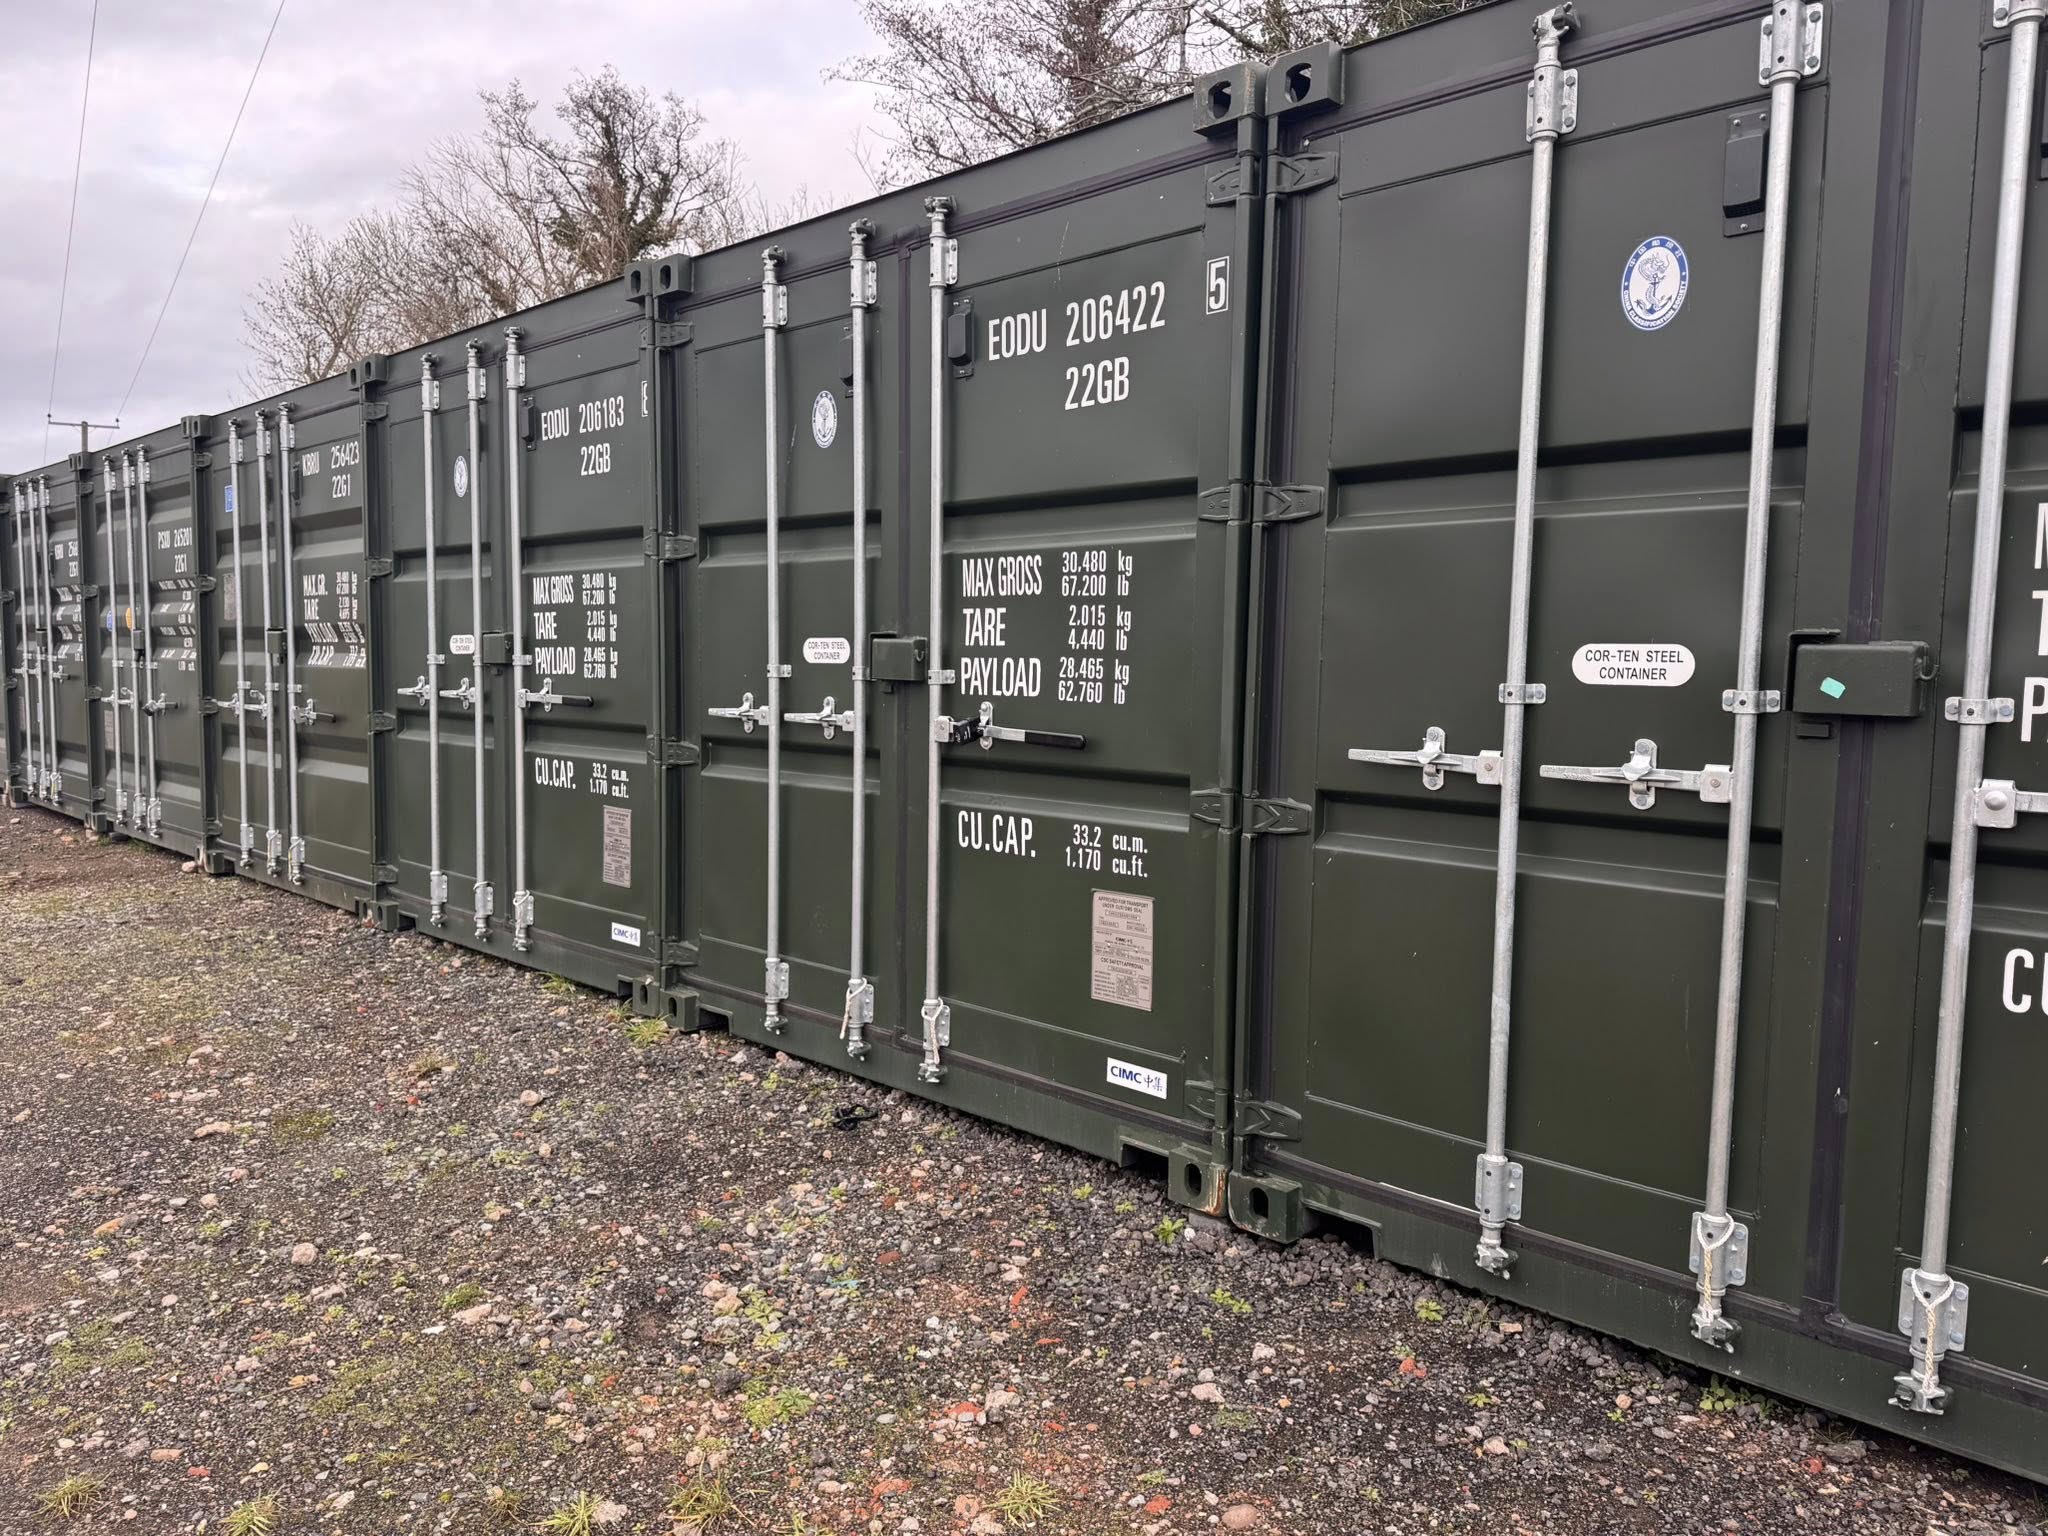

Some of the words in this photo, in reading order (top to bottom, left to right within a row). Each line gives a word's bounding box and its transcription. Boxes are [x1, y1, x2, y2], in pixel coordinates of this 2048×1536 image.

[1209, 260, 1226, 310] 5
[989, 309, 1046, 360] EODU
[1066, 280, 1166, 347] 206422
[1065, 356, 1130, 410] 22GB
[541, 407, 569, 440] EODU
[579, 396, 624, 433] 206183
[331, 441, 359, 469] 256423
[581, 443, 610, 476] 22GB
[332, 474, 351, 498] 22G1
[533, 578, 550, 605] MAX
[551, 575, 574, 604] GROSS
[608, 573, 616, 590] kg
[962, 558, 994, 597] MAX
[998, 555, 1042, 596] GROSS
[1062, 550, 1106, 573] 30,480
[1118, 550, 1133, 576] kg
[1062, 575, 1106, 596] 67,200
[1117, 574, 1129, 596] lb
[534, 612, 557, 640] TARE
[610, 610, 617, 628] kg
[963, 608, 1006, 647] TARE
[1116, 605, 1131, 632] kg
[1116, 629, 1128, 650] lb
[535, 647, 576, 675] PAYLOAD
[1585, 650, 1639, 662] COR-TEN
[1646, 651, 1683, 663] STEEL
[960, 658, 1041, 697] PAYLOAD
[1114, 660, 1130, 686] kg
[1600, 667, 1667, 680] CONTAINER
[1113, 684, 1126, 704] lb
[535, 757, 576, 789] CU.CAP.
[593, 763, 607, 778] 33.2
[958, 810, 1036, 858] CU.CAP.
[1073, 824, 1101, 848] 33.2
[1113, 835, 1148, 854] cu.m.
[1066, 846, 1101, 871] 1,170
[1112, 855, 1148, 878] cu.ft.
[614, 928, 629, 939] CIMC
[1111, 1066, 1141, 1084] CIMC
